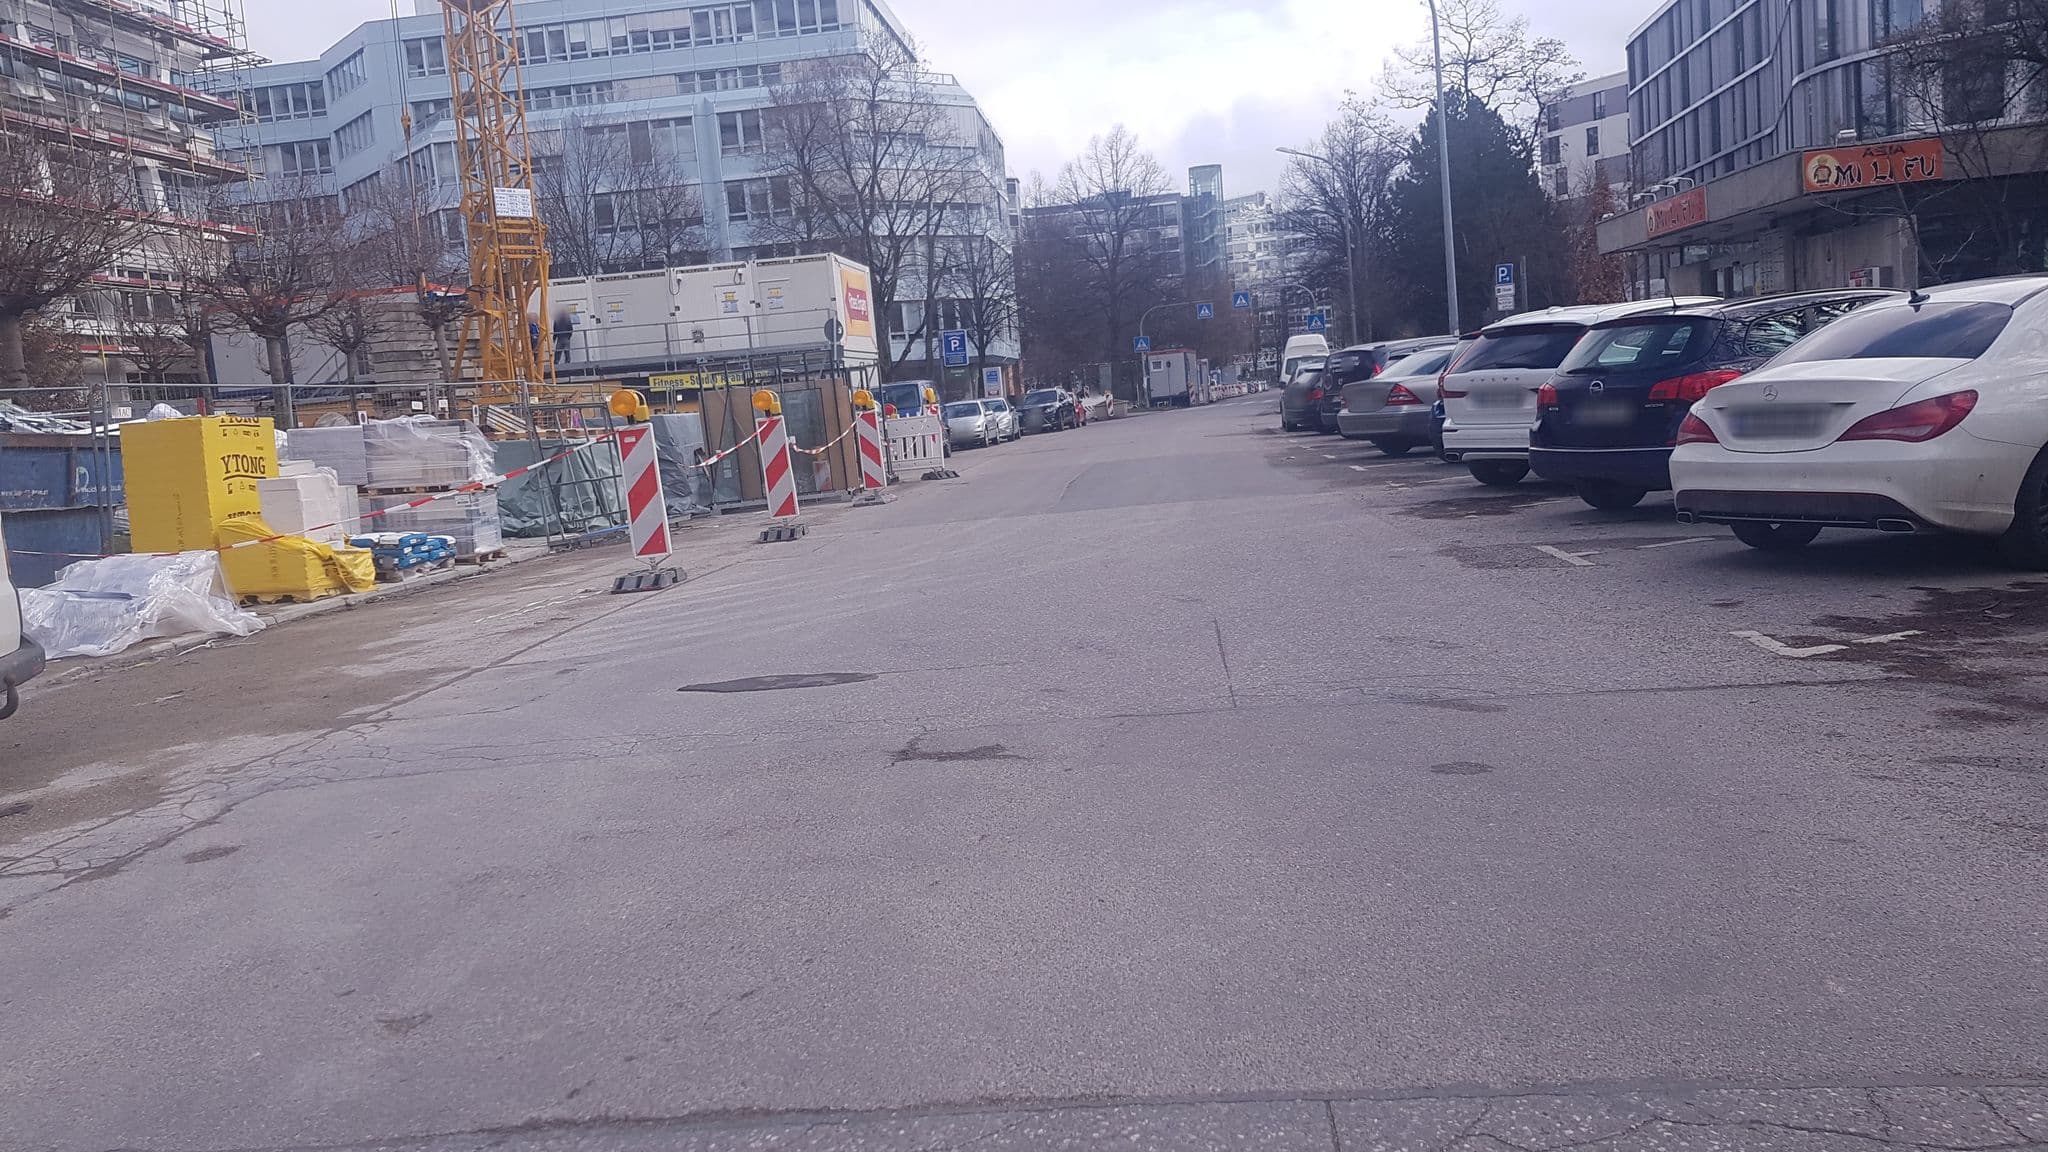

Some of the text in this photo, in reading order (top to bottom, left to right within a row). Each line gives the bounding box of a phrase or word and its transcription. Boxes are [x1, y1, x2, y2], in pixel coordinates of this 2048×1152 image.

[1863, 144, 1905, 158] ASIA
[1834, 154, 1937, 187] MI LI FU
[1498, 267, 1508, 283] P
[950, 339, 960, 352] P
[220, 454, 267, 475] YTONG
